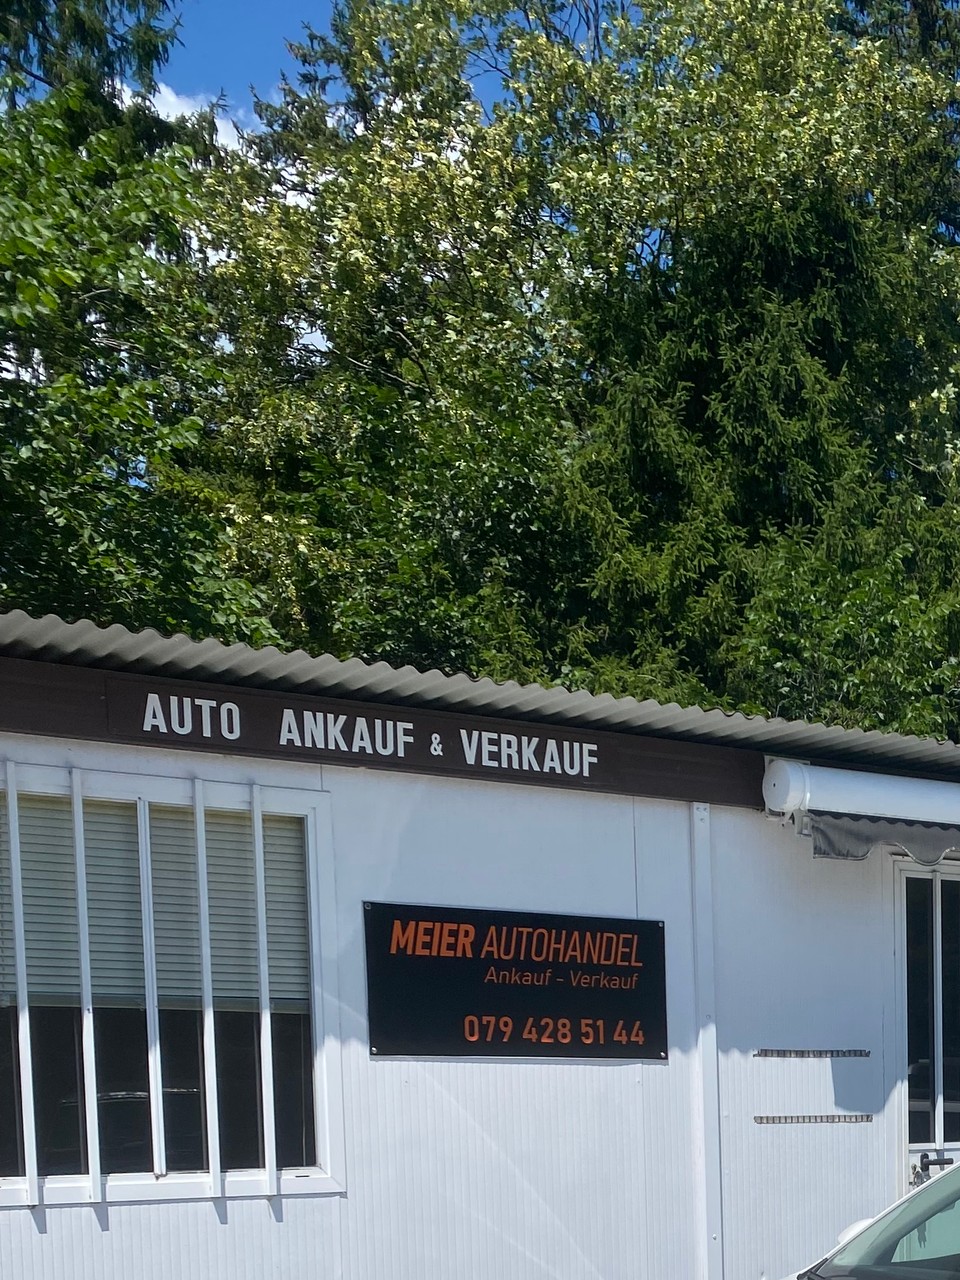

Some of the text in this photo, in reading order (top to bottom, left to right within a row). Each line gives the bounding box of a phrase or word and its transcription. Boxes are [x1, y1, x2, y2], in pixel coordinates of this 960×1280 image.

[142, 692, 599, 778] AUTO ANKAUF & VERKAUF
[389, 919, 643, 967] MEIER AUTOHANDEL
[484, 966, 552, 986] Ankauf
[570, 969, 639, 990] Verkauf
[463, 1014, 645, 1046] 079 428 51 44
